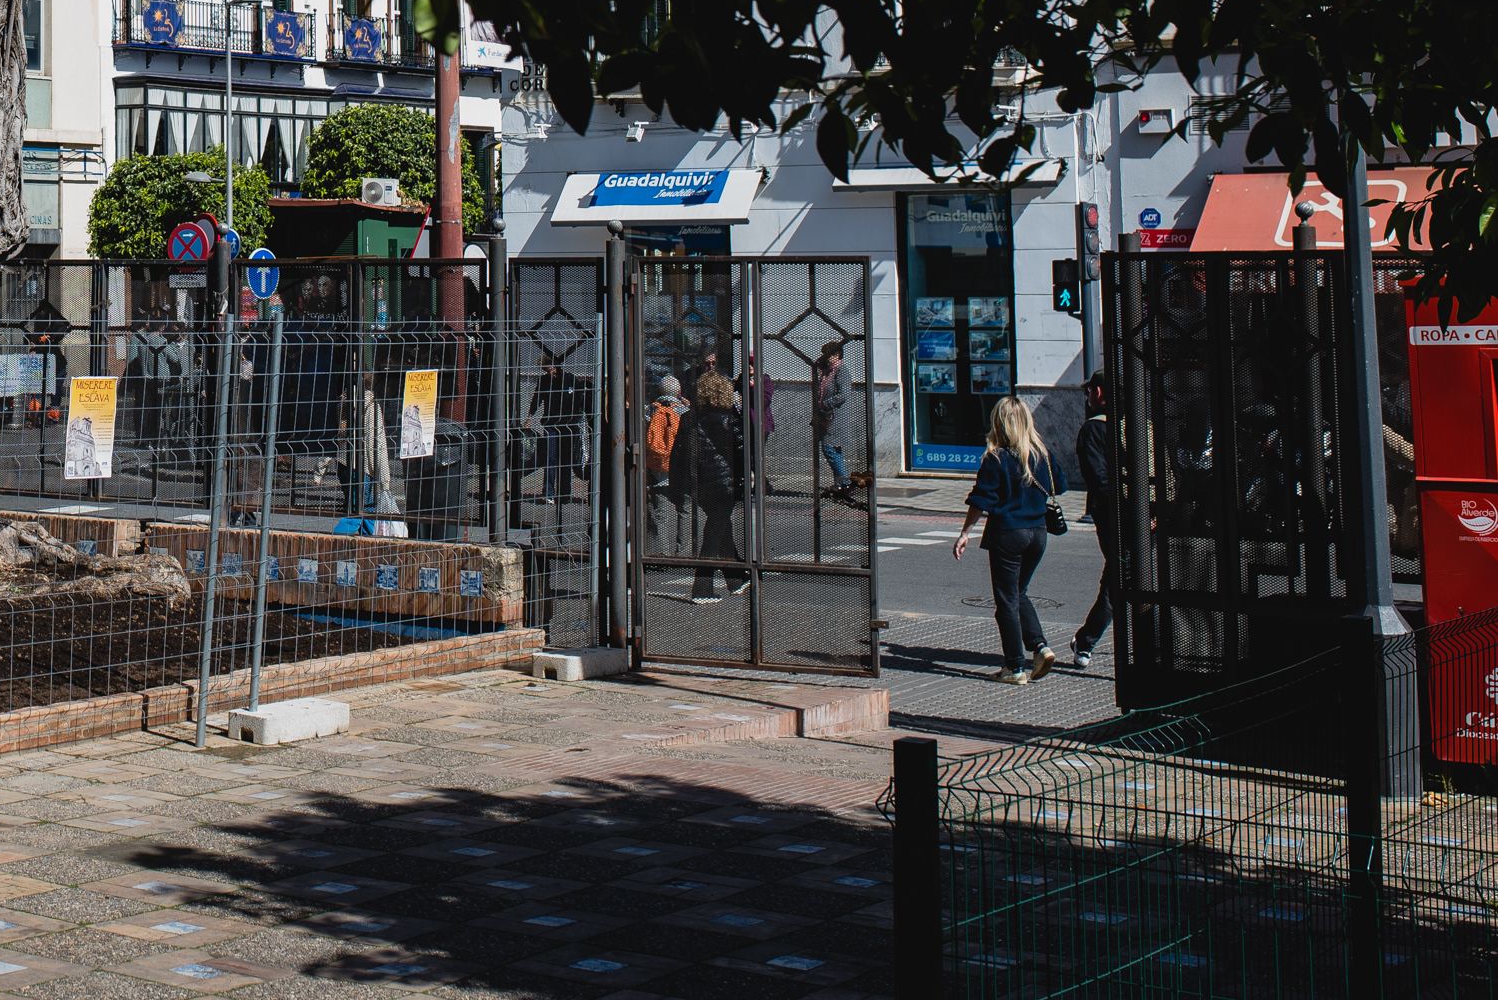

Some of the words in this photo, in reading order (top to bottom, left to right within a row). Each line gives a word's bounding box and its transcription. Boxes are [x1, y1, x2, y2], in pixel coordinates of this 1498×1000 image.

[510, 79, 545, 91] COR
[604, 171, 716, 189] Guadalquivir
[926, 208, 1006, 224] Guadalquivi
[1143, 213, 1158, 222] ADT
[1156, 234, 1188, 243] ZERO
[1420, 329, 1461, 341] ROPA
[1474, 329, 1498, 341] CA
[75, 380, 115, 390] MISERERE
[926, 452, 947, 462] 689
[948, 454, 962, 463] 28
[963, 454, 977, 464] 22
[1461, 500, 1477, 509] BIO
